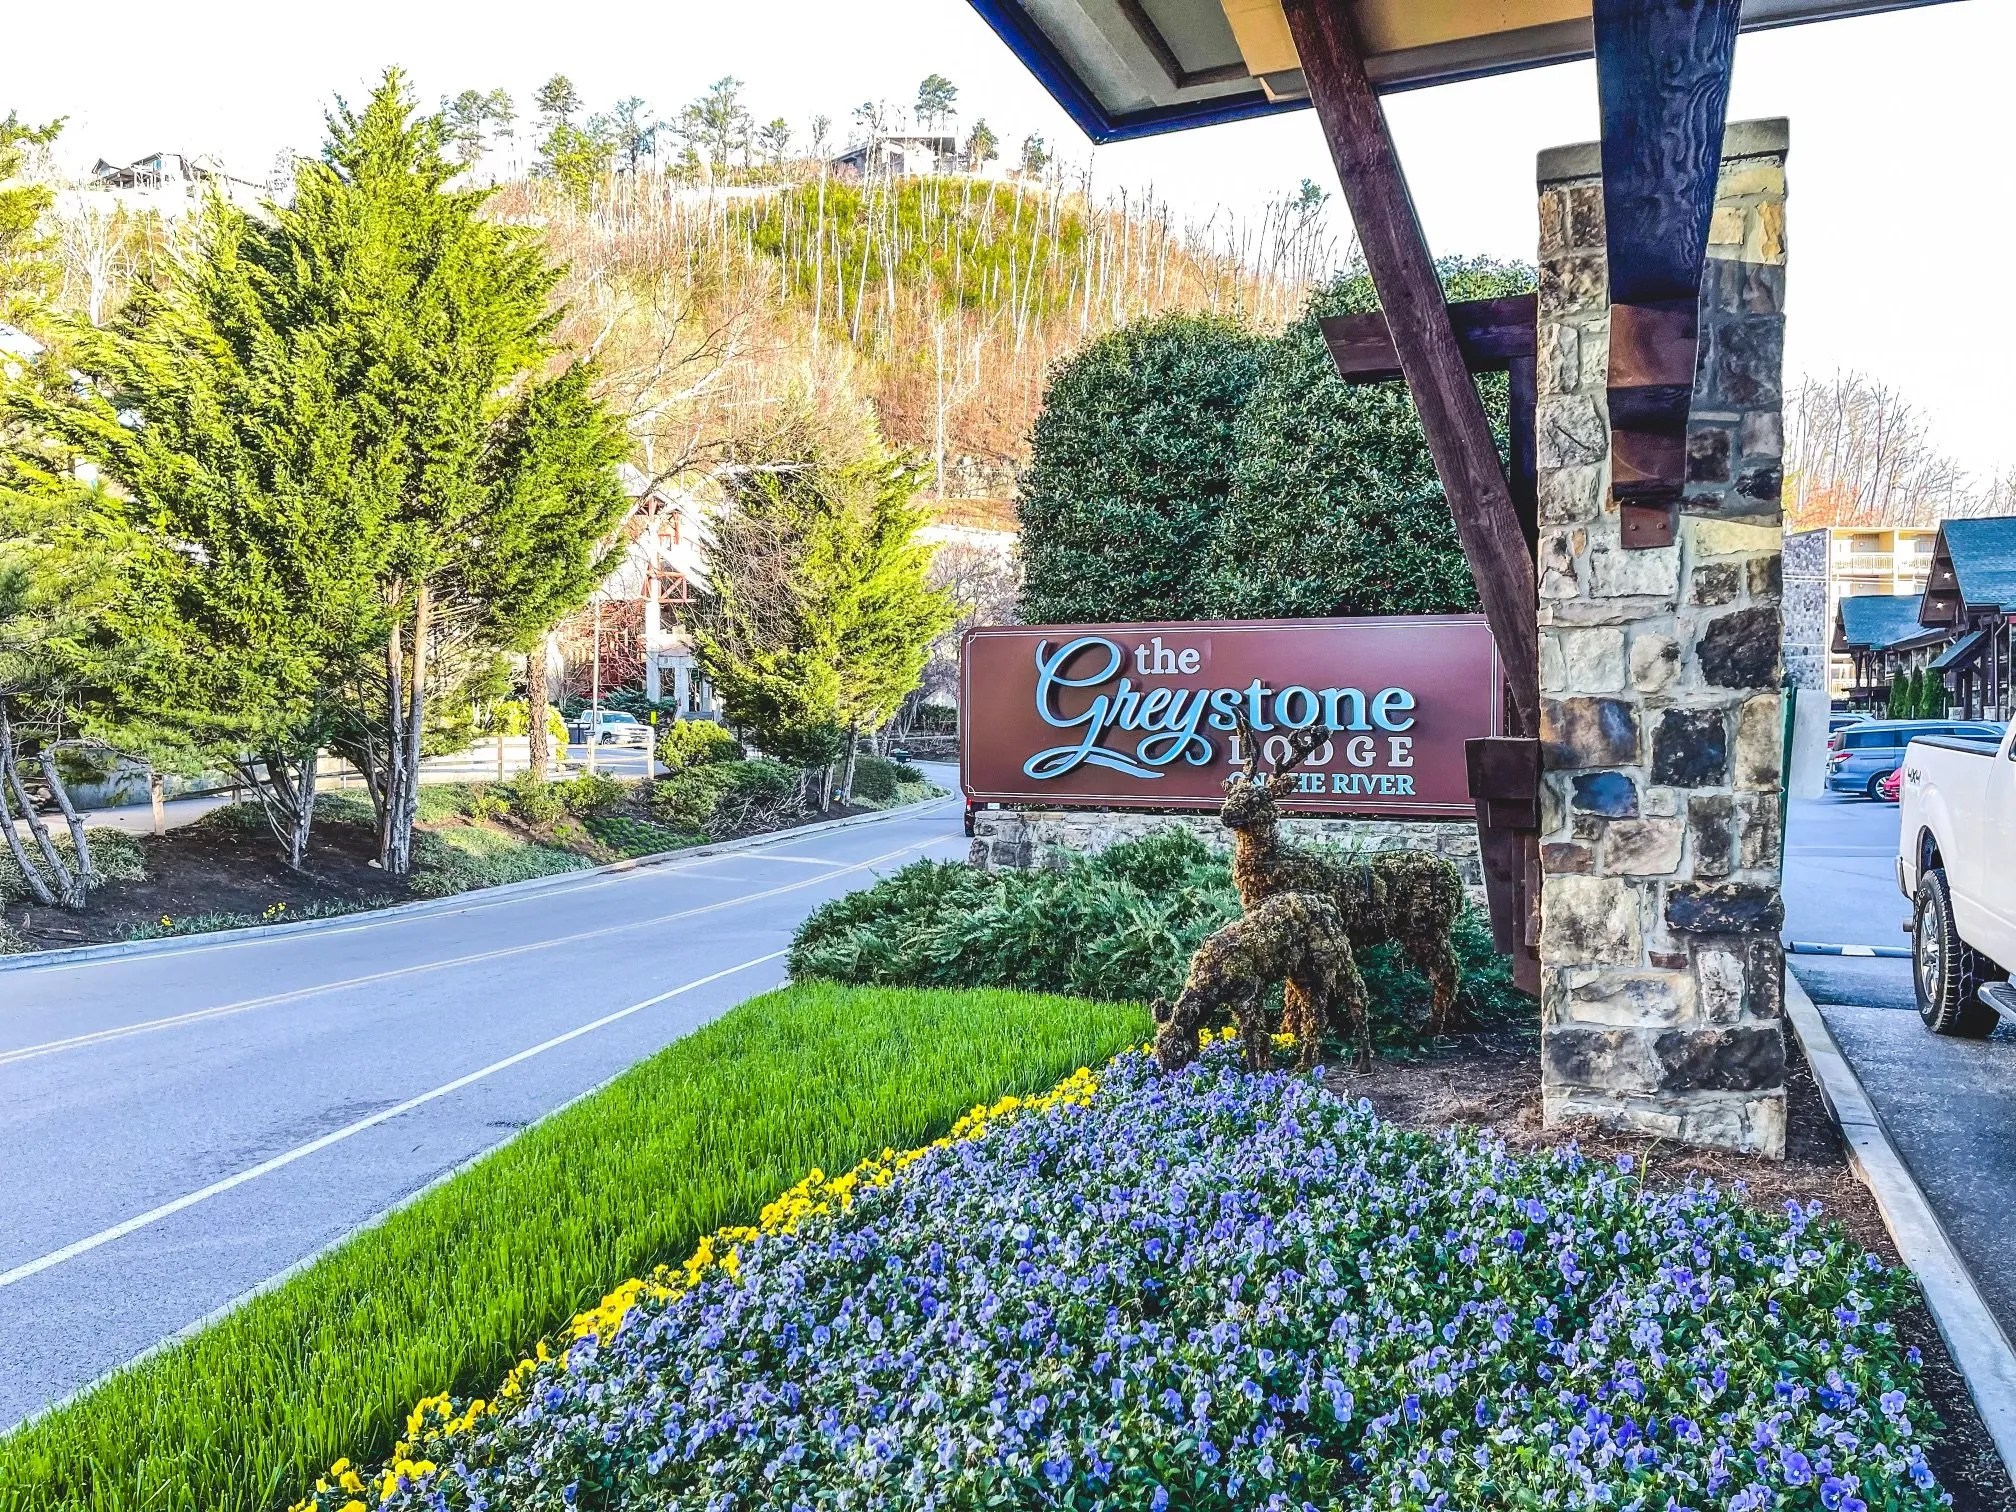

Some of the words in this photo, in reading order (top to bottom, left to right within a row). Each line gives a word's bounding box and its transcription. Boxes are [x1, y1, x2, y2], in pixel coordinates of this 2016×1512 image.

[1134, 636, 1201, 675] the
[1023, 636, 1415, 779] Greystone
[1227, 735, 1414, 768] LODGE
[1275, 772, 1326, 793] HE
[1331, 773, 1416, 796] RIVER
